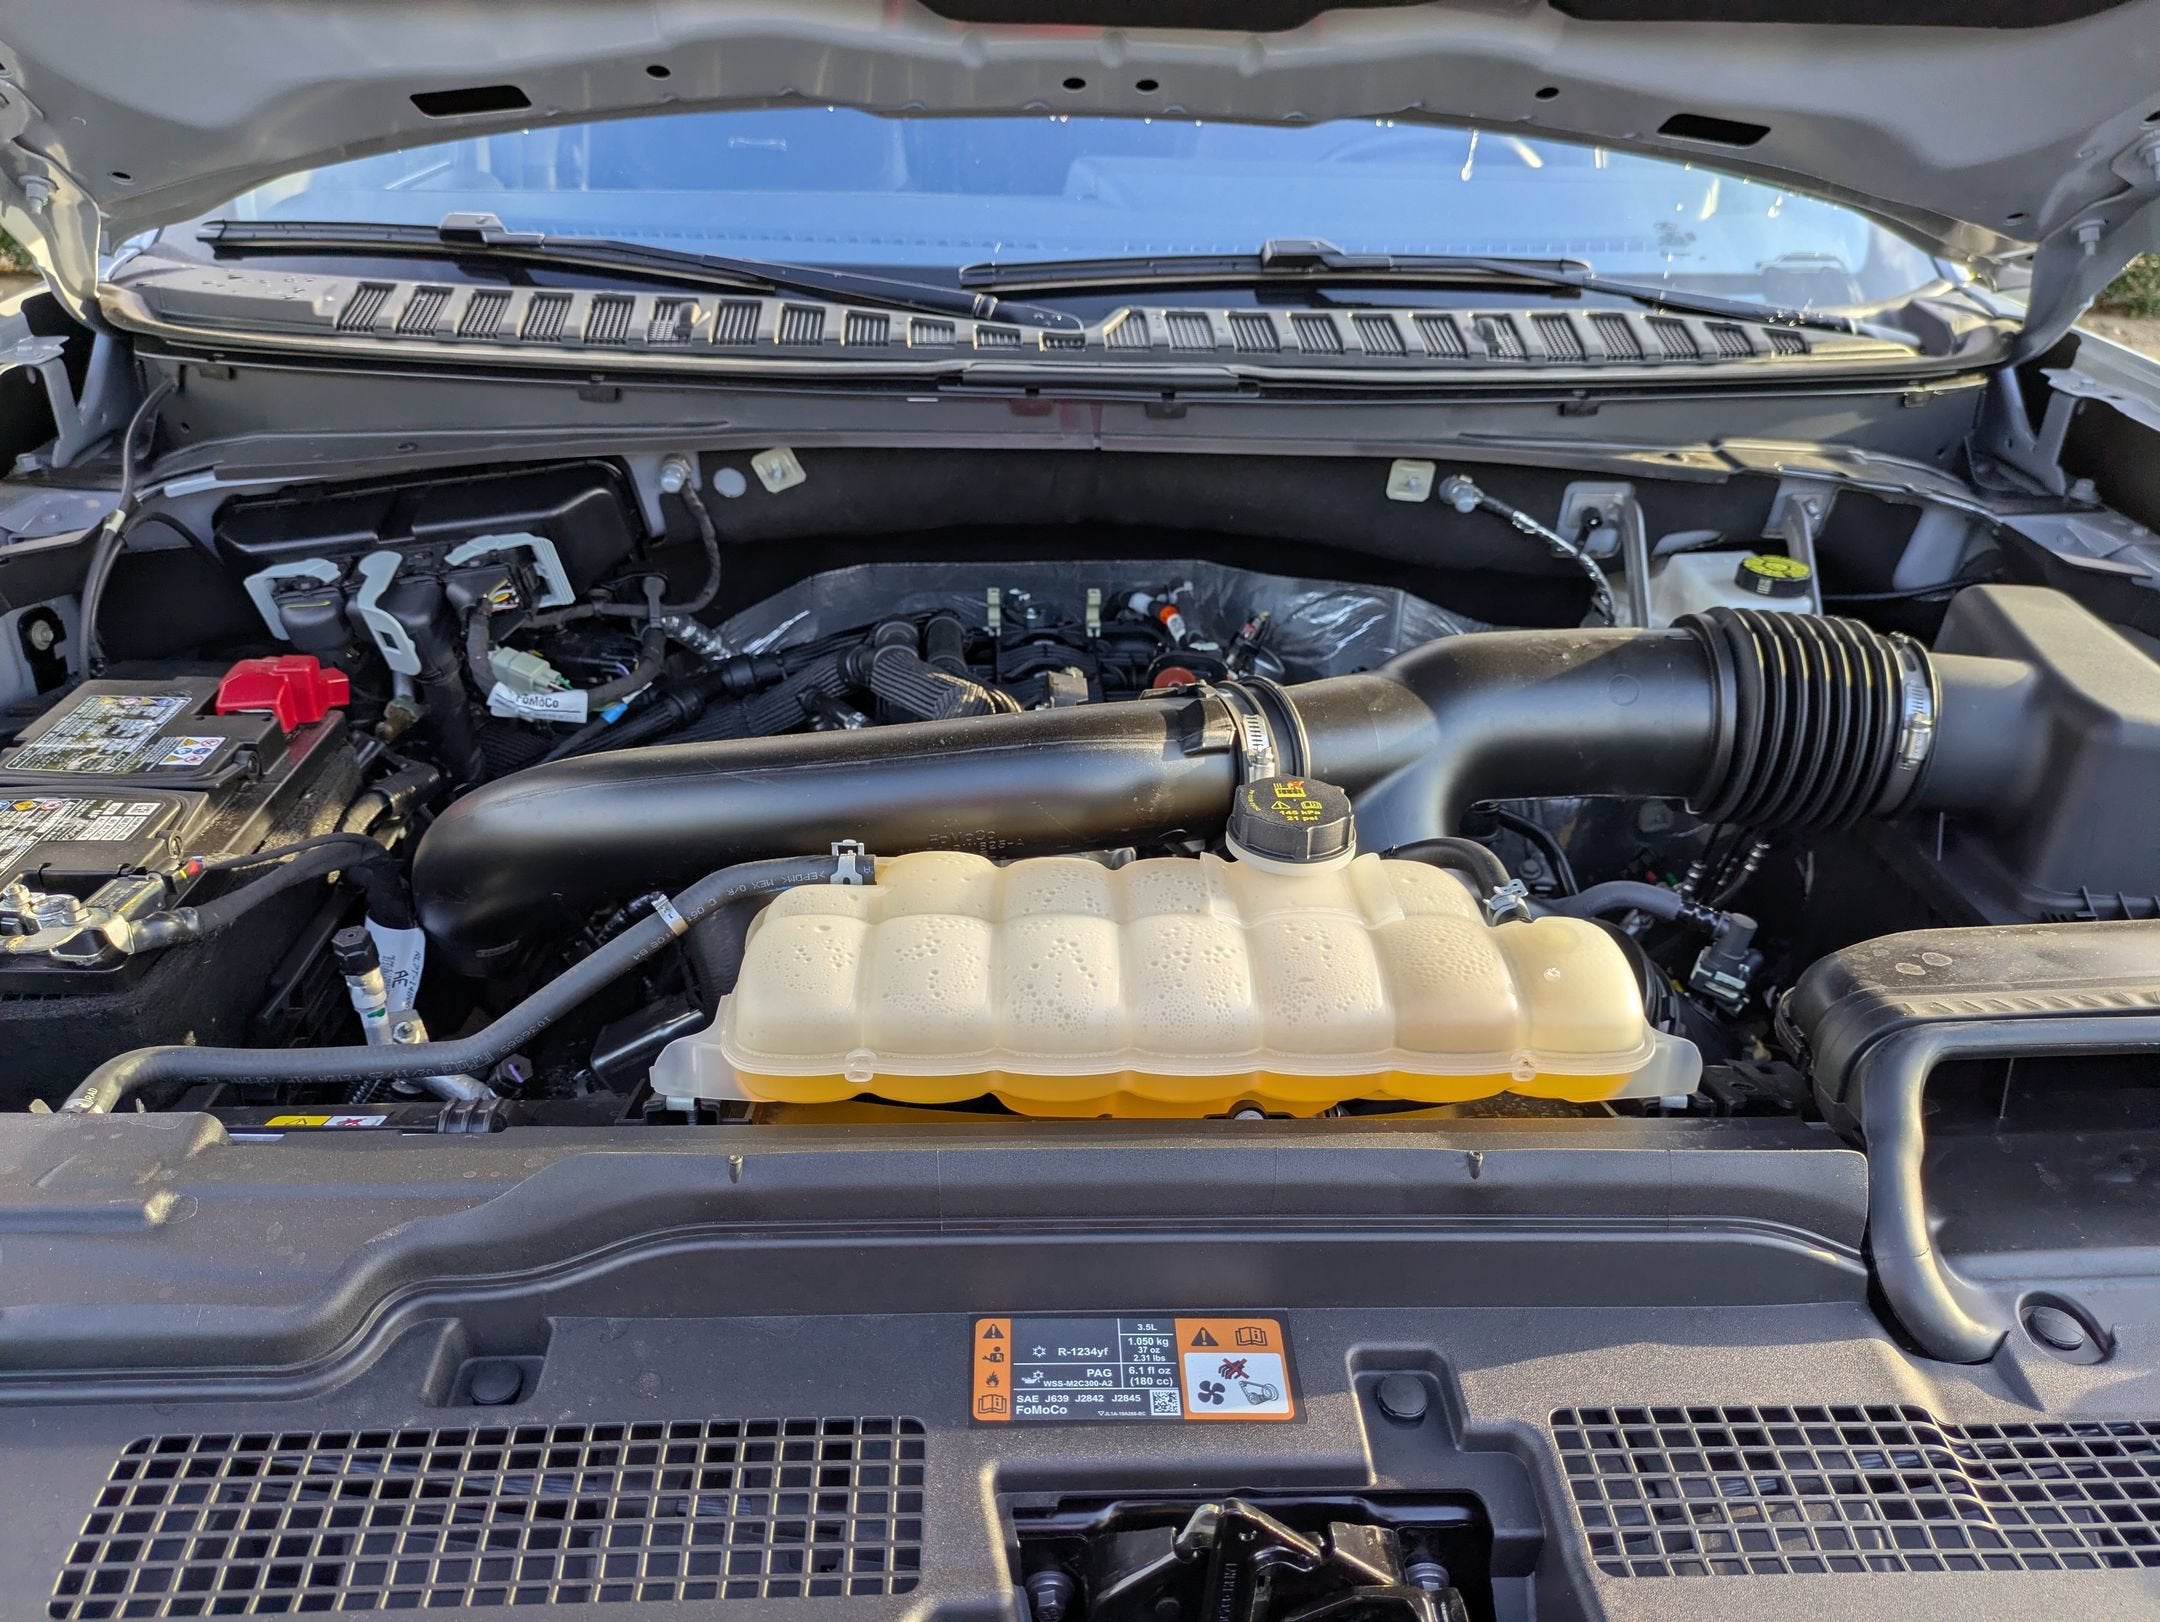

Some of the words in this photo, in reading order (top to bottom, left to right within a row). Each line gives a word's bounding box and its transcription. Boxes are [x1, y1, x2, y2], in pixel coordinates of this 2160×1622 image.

[392, 970, 409, 990] AE
[1128, 1337, 1154, 1346] 1.050
[1156, 1337, 1169, 1347] kg
[1058, 1347, 1108, 1357] R-1234yf
[1133, 1354, 1150, 1362] 2.31
[1087, 1369, 1112, 1377] PAG
[1128, 1366, 1143, 1374] 6.1
[1146, 1366, 1155, 1375] fl
[1130, 1377, 1152, 1387] (180
[1156, 1377, 1173, 1387] cc)
[1016, 1394, 1039, 1402] SAE
[1044, 1394, 1069, 1402] J639
[1074, 1394, 1104, 1402] J2842
[1111, 1394, 1141, 1402] J2845
[1016, 1404, 1068, 1415] FoMoCo
